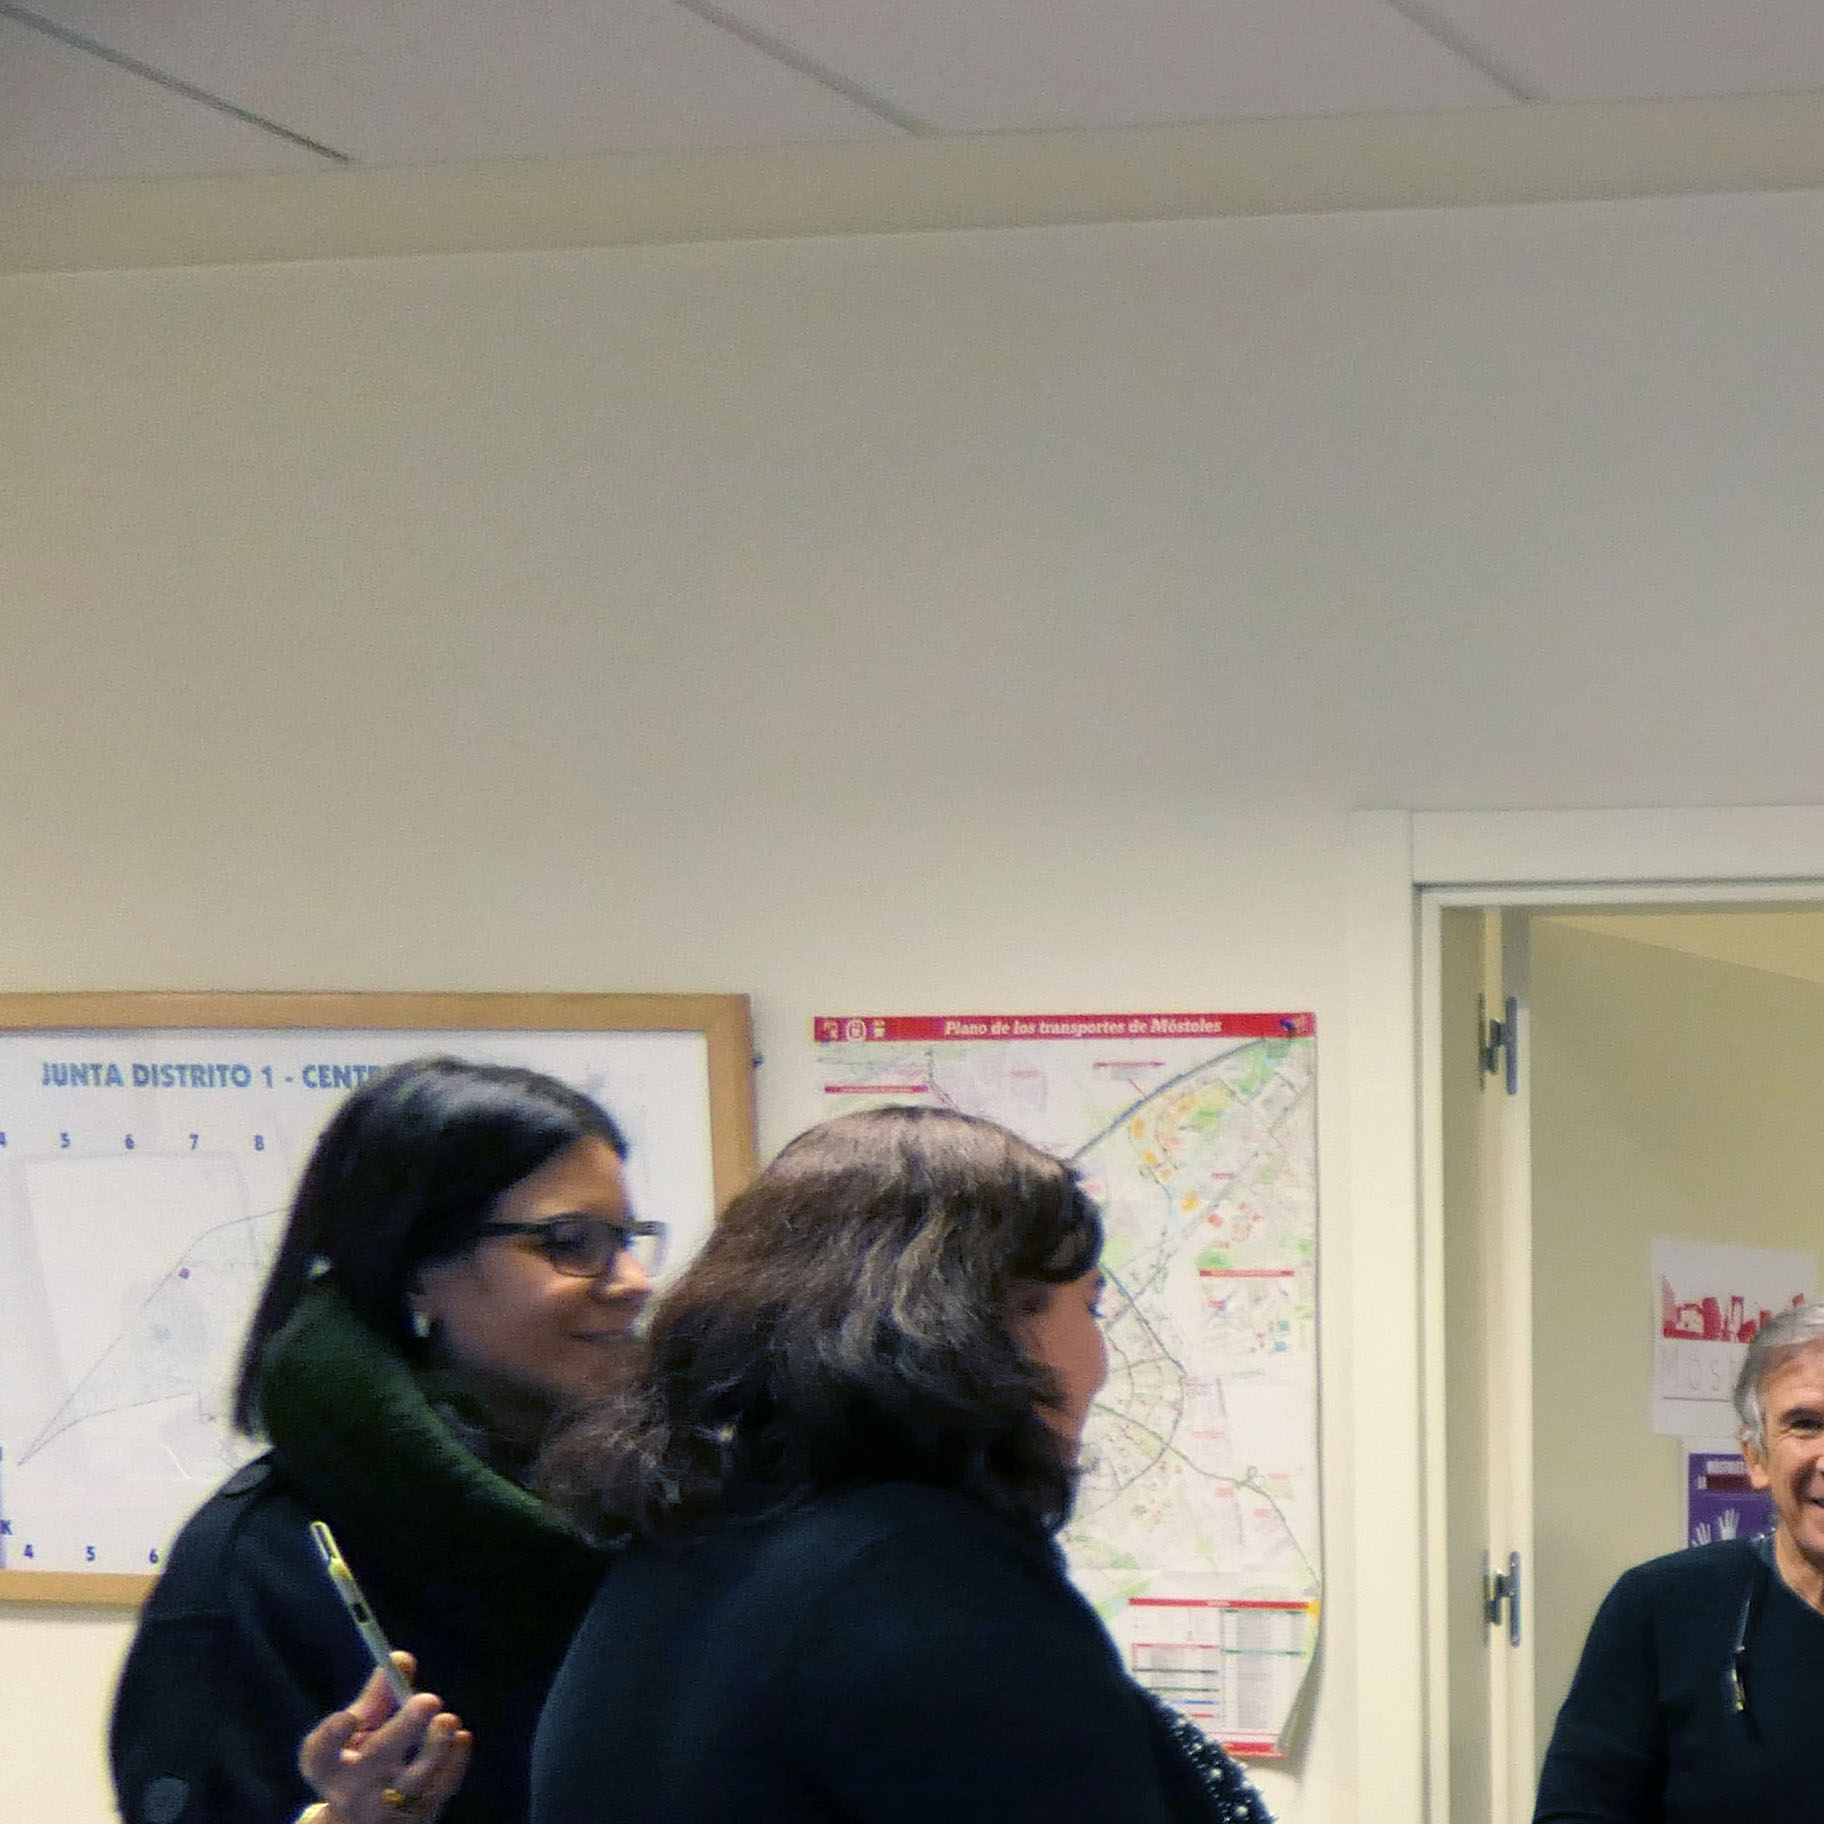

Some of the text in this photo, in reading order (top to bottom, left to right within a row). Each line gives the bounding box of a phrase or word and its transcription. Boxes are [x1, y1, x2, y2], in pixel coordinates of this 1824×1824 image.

[945, 1017, 1222, 1037] Plano de los transportes de Móstoles
[41, 1061, 125, 1088] JUNTA
[132, 1063, 252, 1089] DISTRITO
[261, 1064, 274, 1089] 1
[60, 1133, 71, 1148] 5
[125, 1134, 135, 1150] 6
[190, 1134, 199, 1149] 7
[24, 1544, 159, 1564] 4 5 6
